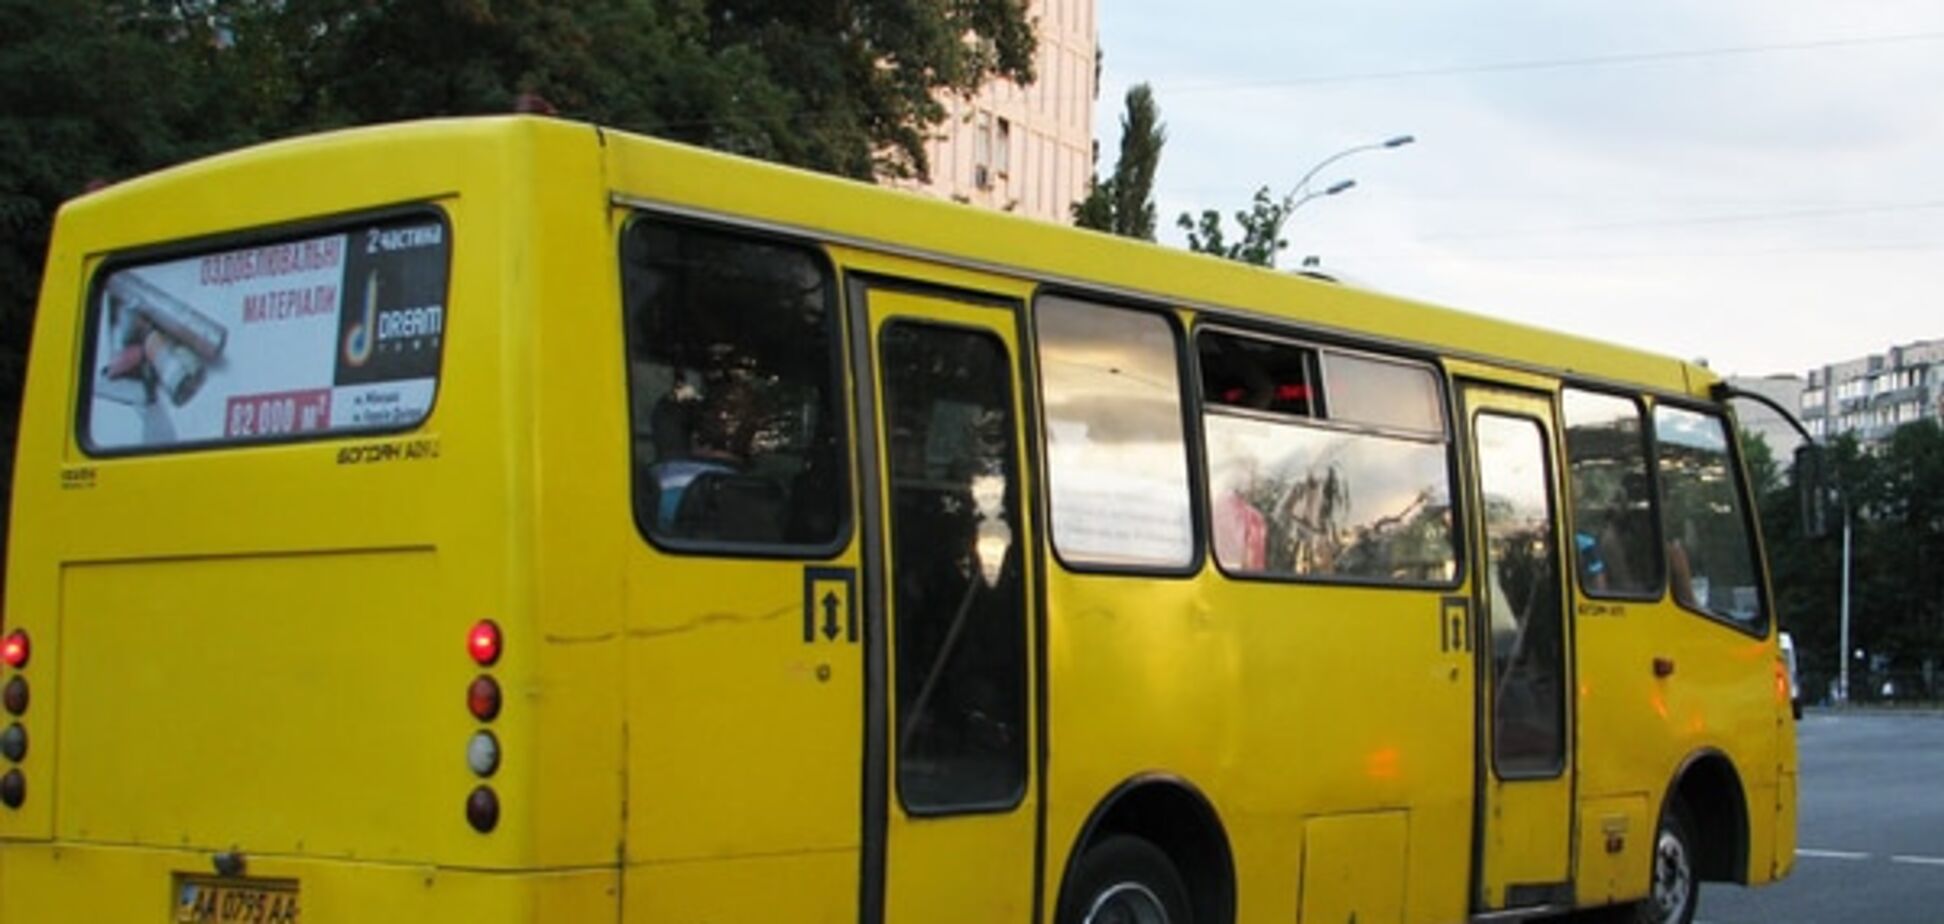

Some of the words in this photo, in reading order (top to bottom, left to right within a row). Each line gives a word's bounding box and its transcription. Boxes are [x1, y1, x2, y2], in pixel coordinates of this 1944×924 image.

[366, 228, 380, 253] 2
[381, 224, 442, 250] частина
[243, 286, 336, 323] МАТЕРІАЛИ
[378, 306, 442, 339] DREAM
[259, 398, 295, 434] 000
[191, 889, 217, 924] AA
[269, 896, 300, 924] AA
